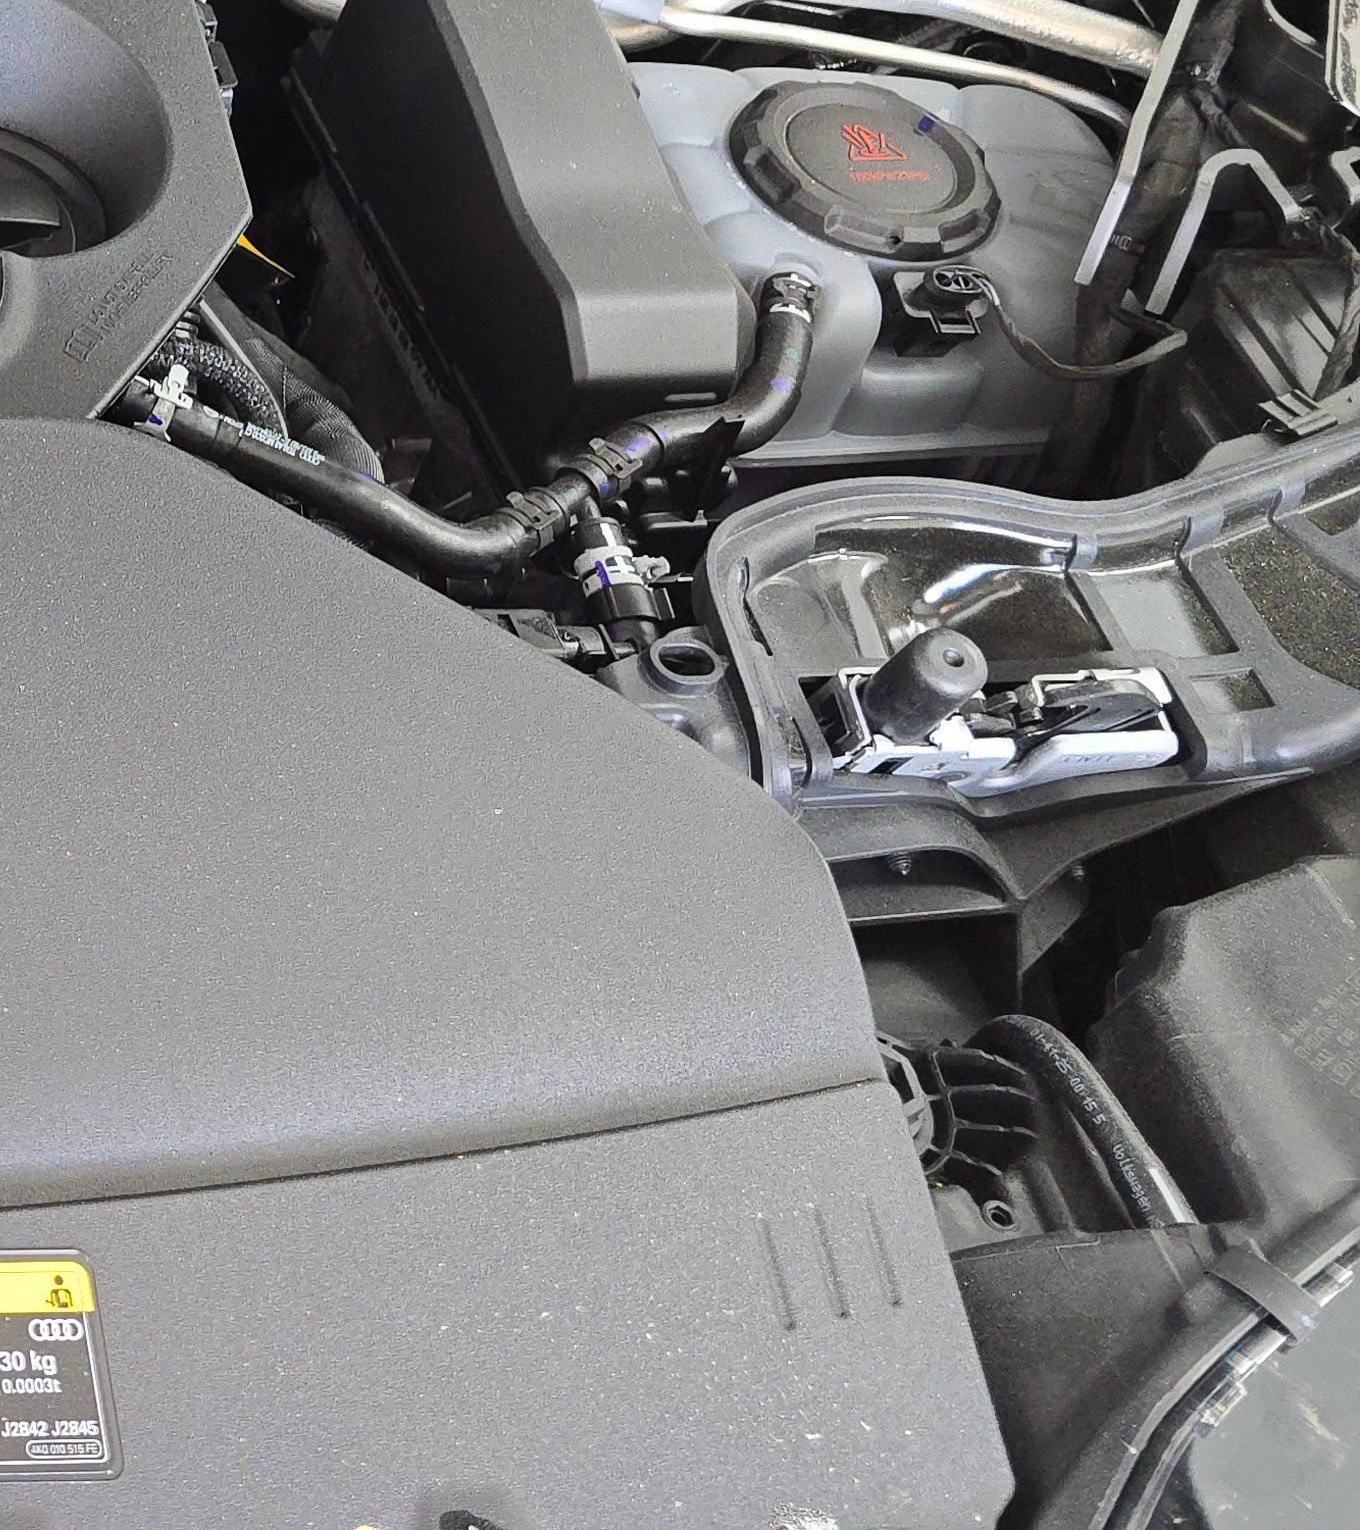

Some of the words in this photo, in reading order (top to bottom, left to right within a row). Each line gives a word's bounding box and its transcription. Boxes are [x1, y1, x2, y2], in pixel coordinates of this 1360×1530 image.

[30, 1349, 57, 1375] kg
[1, 1420, 49, 1437] J2842
[51, 1420, 100, 1436] J2845
